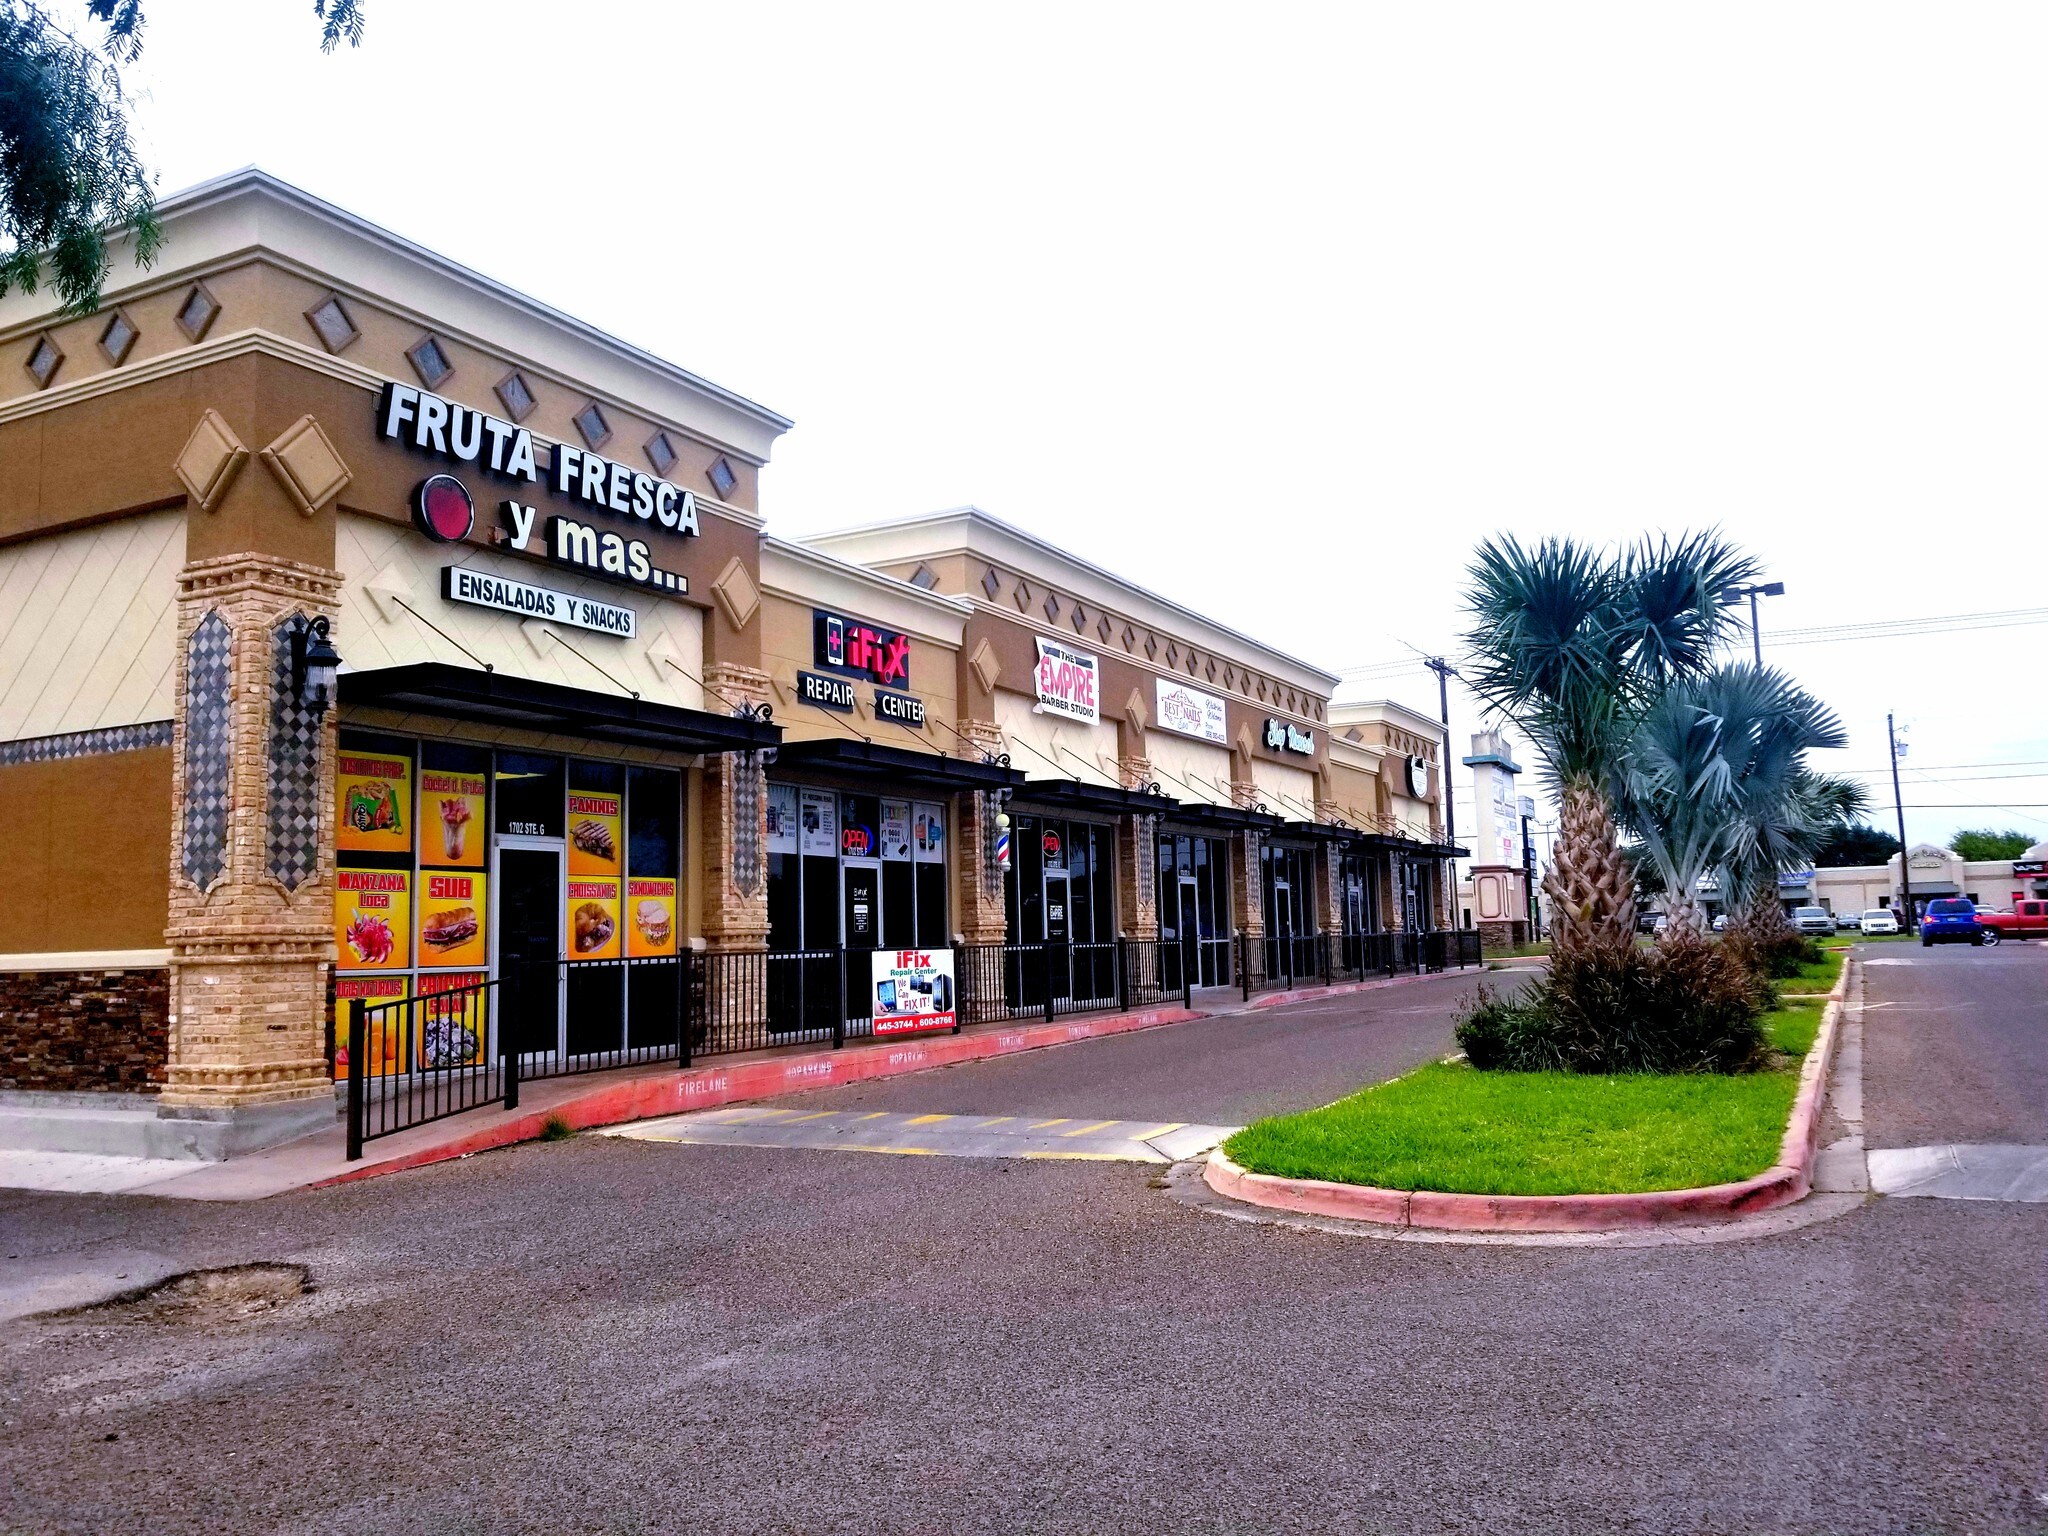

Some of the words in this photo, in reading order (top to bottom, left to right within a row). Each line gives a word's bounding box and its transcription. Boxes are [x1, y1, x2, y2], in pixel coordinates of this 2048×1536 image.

[386, 383, 537, 482] FRUTA
[560, 444, 700, 537] FRESCA
[510, 501, 537, 549] y
[558, 518, 688, 593] mas...
[459, 574, 556, 615] ENSALADAS
[567, 601, 577, 621] Y
[582, 604, 631, 633] SNACKS
[1061, 651, 1075, 664] THE
[1041, 656, 1094, 707] EMPIRE
[806, 677, 854, 706] REPAIR
[882, 695, 925, 722] CENTER
[1041, 694, 1069, 711] BARBER
[1071, 703, 1094, 718] STUDIO
[1165, 701, 1179, 716] BEST
[1184, 707, 1201, 723] NAILS
[568, 797, 618, 816] PANINIS
[509, 821, 523, 834] 1702
[525, 823, 538, 835] STE.
[540, 824, 545, 835] G
[842, 829, 869, 848] OPEN
[1043, 837, 1058, 850] OPEN
[337, 872, 407, 892] MANZANA
[429, 876, 473, 900] SUB
[568, 882, 617, 899] CROISSANTS
[628, 881, 674, 897] SANDWICHES
[359, 892, 389, 908] Loca
[897, 950, 931, 968] iFix
[890, 969, 913, 977] Repair
[360, 979, 402, 997] NATURALES
[898, 979, 907, 988] We
[898, 989, 909, 999] Can
[904, 999, 918, 1010] FIX
[920, 997, 930, 1008] IT!
[877, 1019, 913, 1031] 445-3744
[919, 1016, 953, 1027] 600-8766
[678, 1077, 728, 1097] FIRELANE
